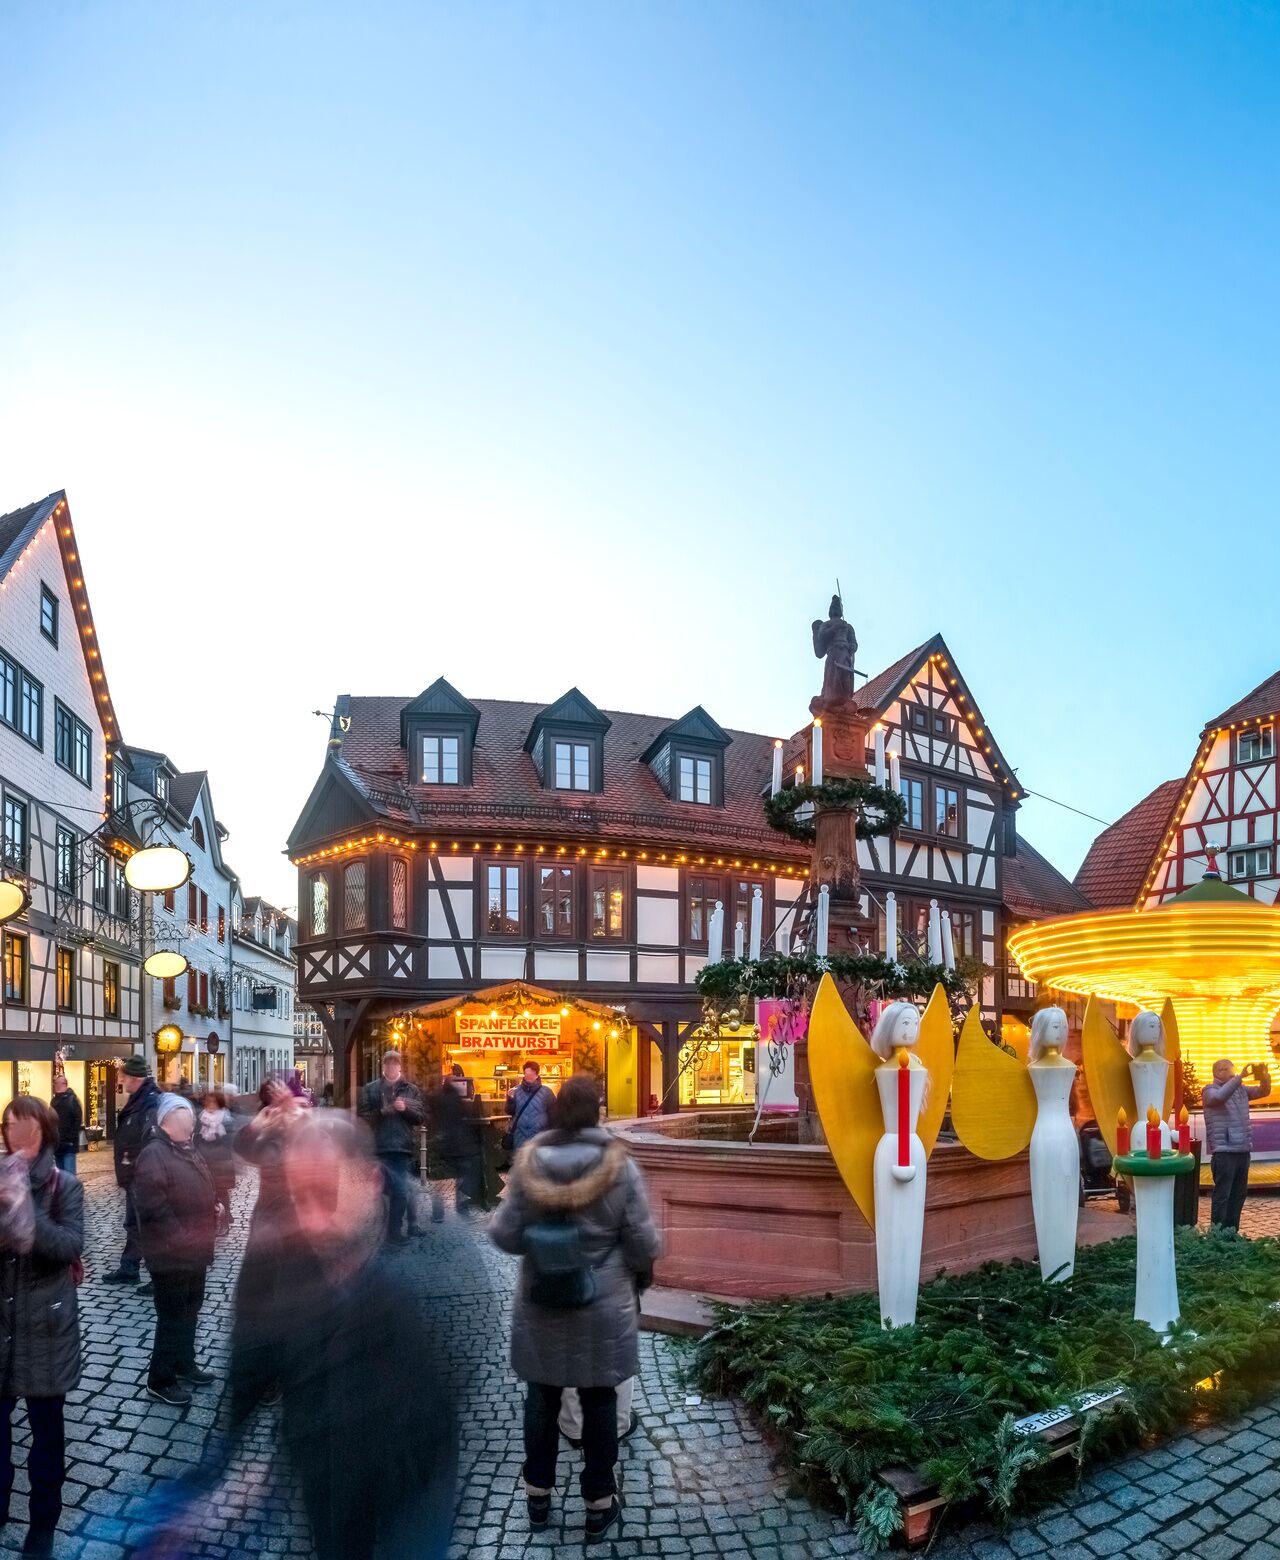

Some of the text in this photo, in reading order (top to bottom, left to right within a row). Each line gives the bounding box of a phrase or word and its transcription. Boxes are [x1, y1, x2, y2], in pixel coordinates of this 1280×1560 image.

[459, 1018, 560, 1030] SPANFERKEL-
[461, 1036, 557, 1049] BRATWURST
[1035, 1407, 1073, 1426] nicht
